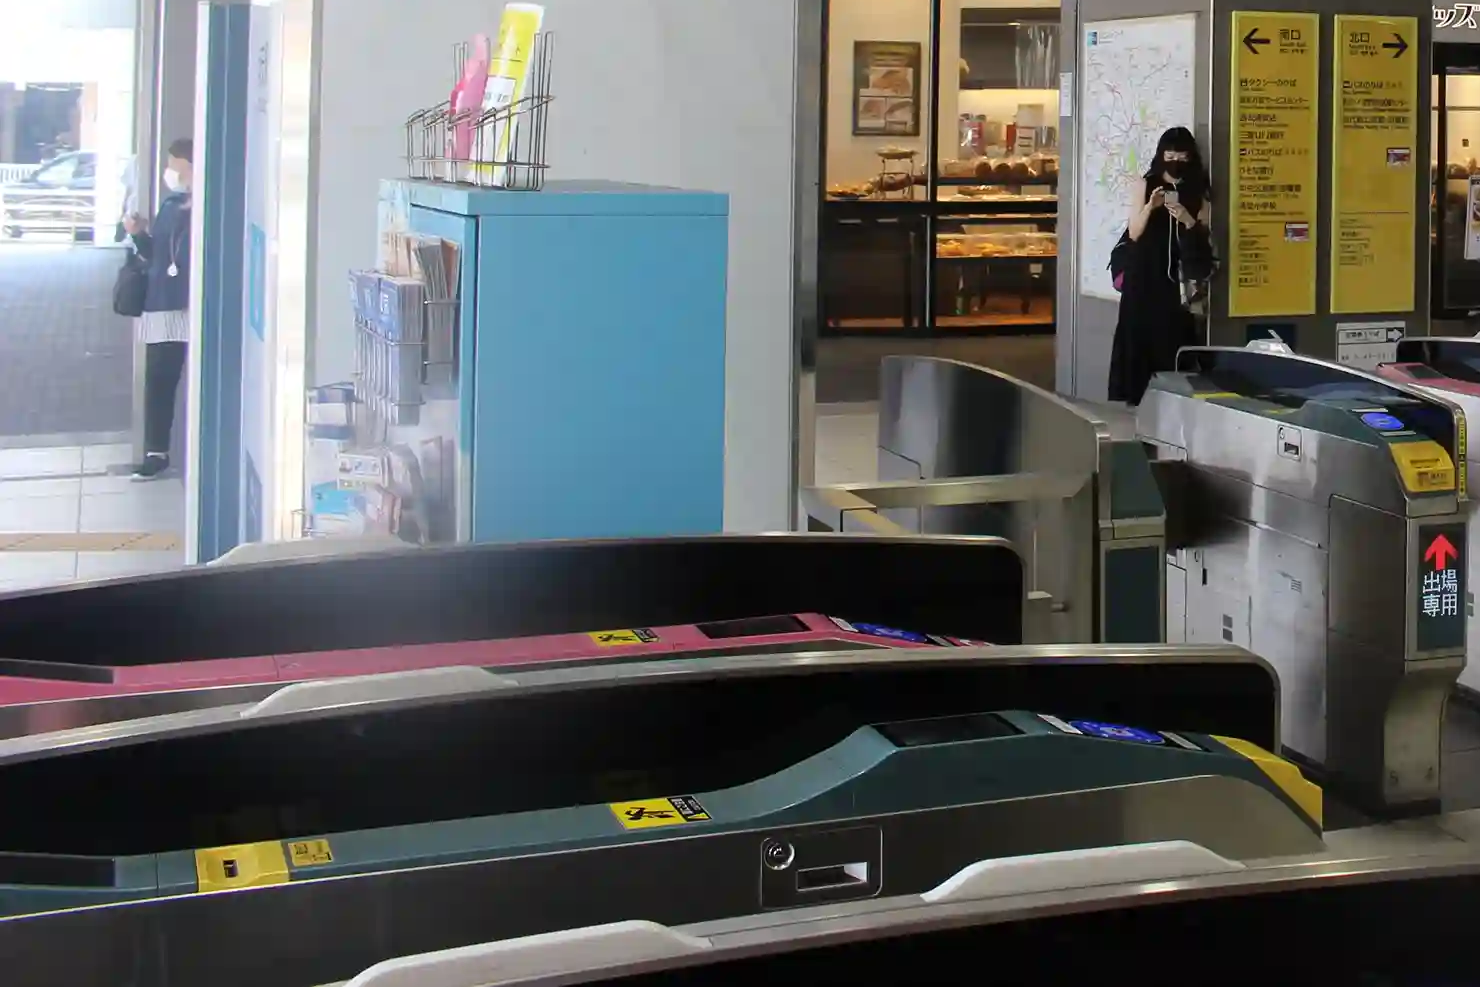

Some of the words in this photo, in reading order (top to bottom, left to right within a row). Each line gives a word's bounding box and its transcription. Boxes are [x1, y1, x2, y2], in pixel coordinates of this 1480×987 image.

[1432, 2, 1480, 29] ッズ
[1422, 569, 1458, 593] 出場
[1422, 593, 1458, 617] 専用
